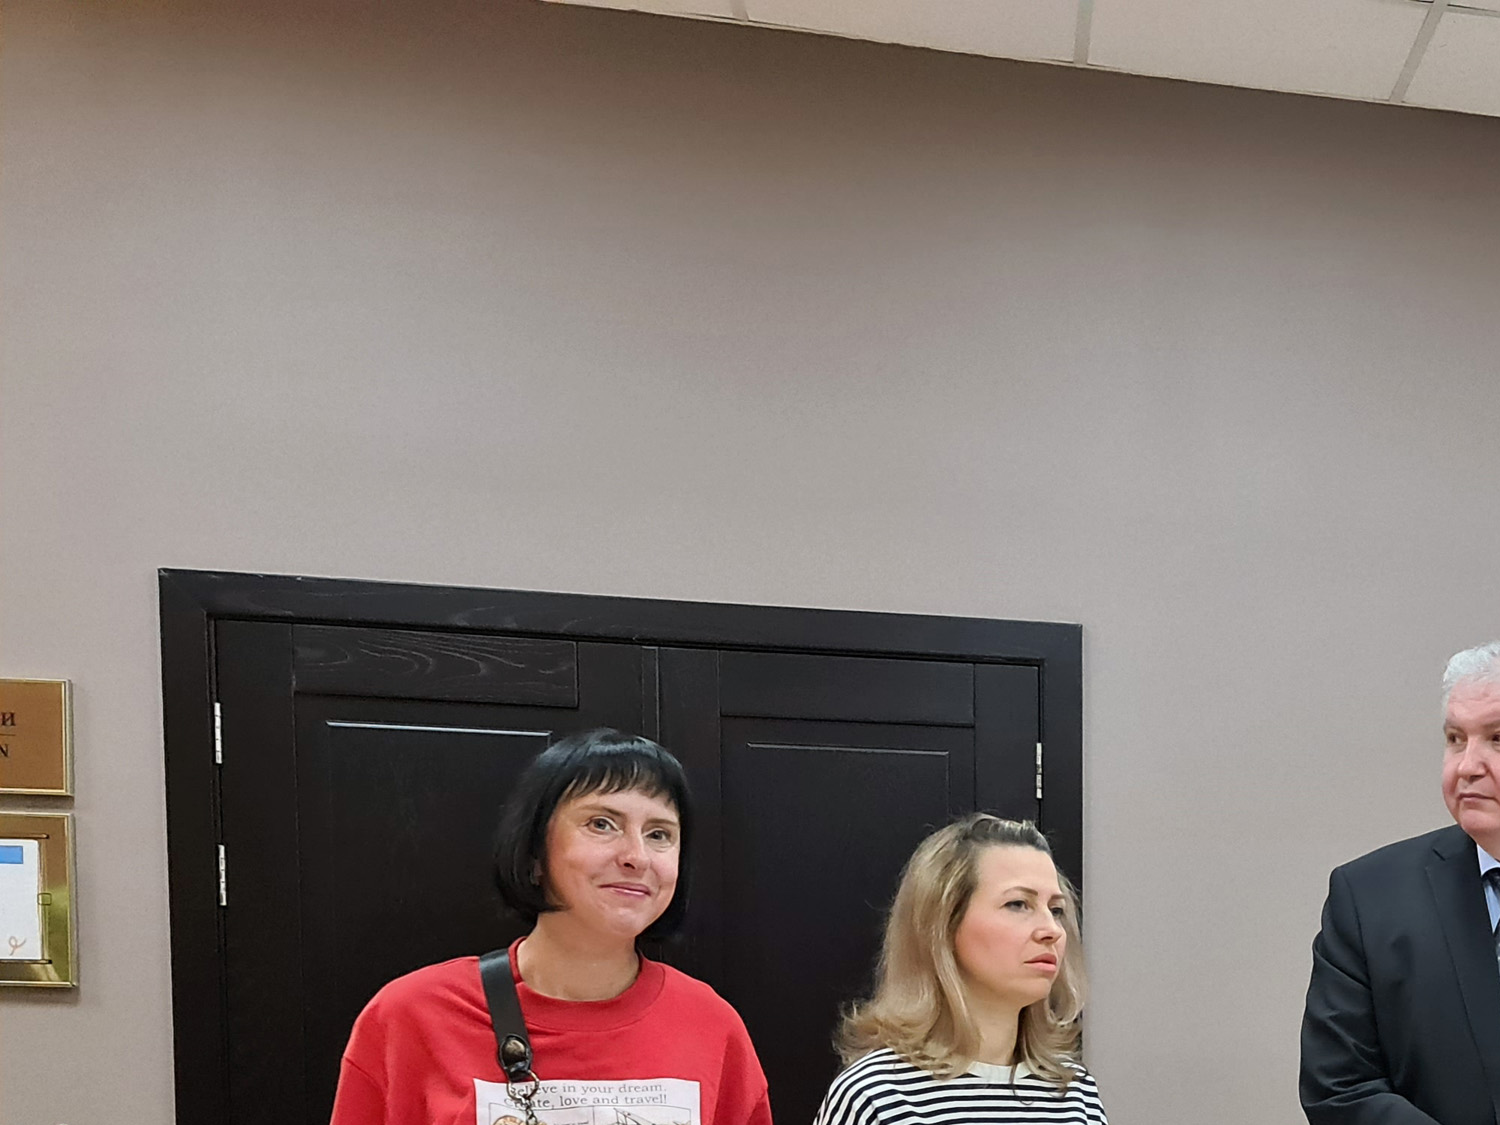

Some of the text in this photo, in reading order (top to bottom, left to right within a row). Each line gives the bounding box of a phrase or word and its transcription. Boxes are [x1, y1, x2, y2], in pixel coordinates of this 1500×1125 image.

[563, 1083, 576, 1093] in
[581, 1084, 614, 1095] your
[560, 1096, 590, 1106] love
[592, 1096, 620, 1105] and
